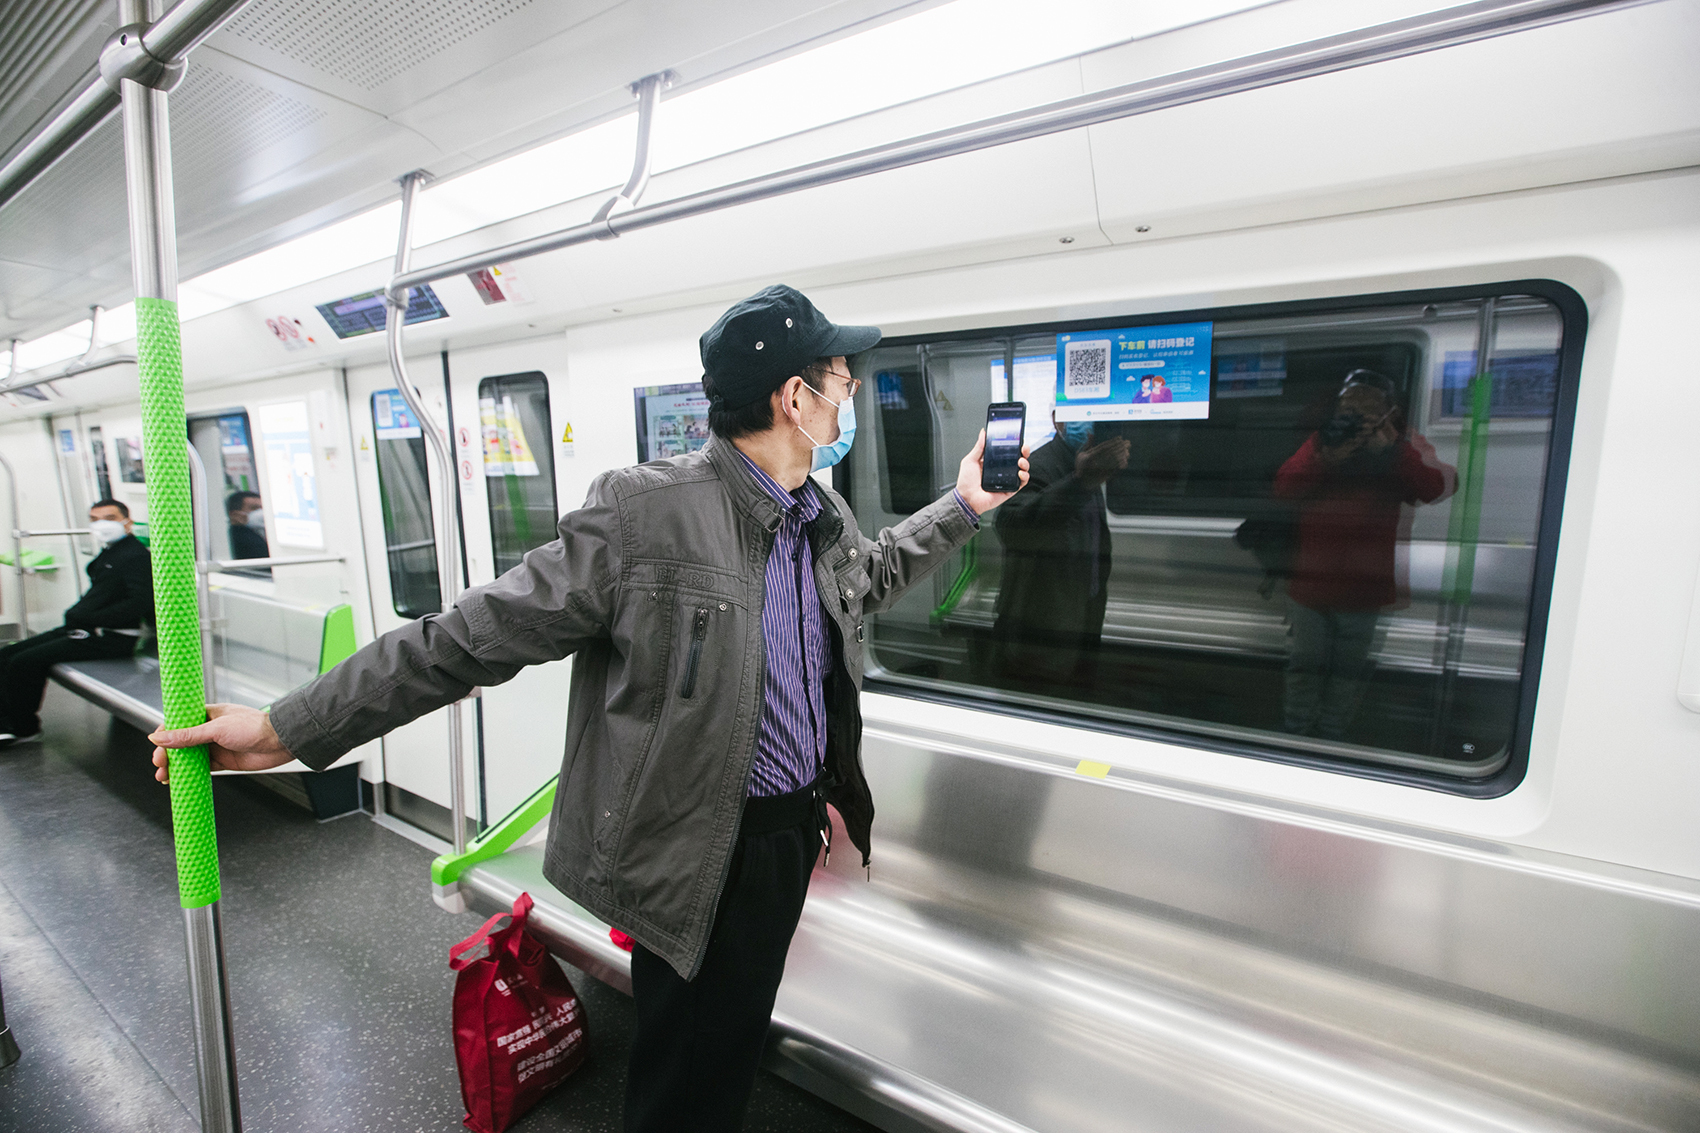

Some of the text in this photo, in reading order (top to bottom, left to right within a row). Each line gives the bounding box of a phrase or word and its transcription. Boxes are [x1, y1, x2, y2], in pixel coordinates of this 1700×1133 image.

[1118, 336, 1195, 351] 下车前 请扫码登记
